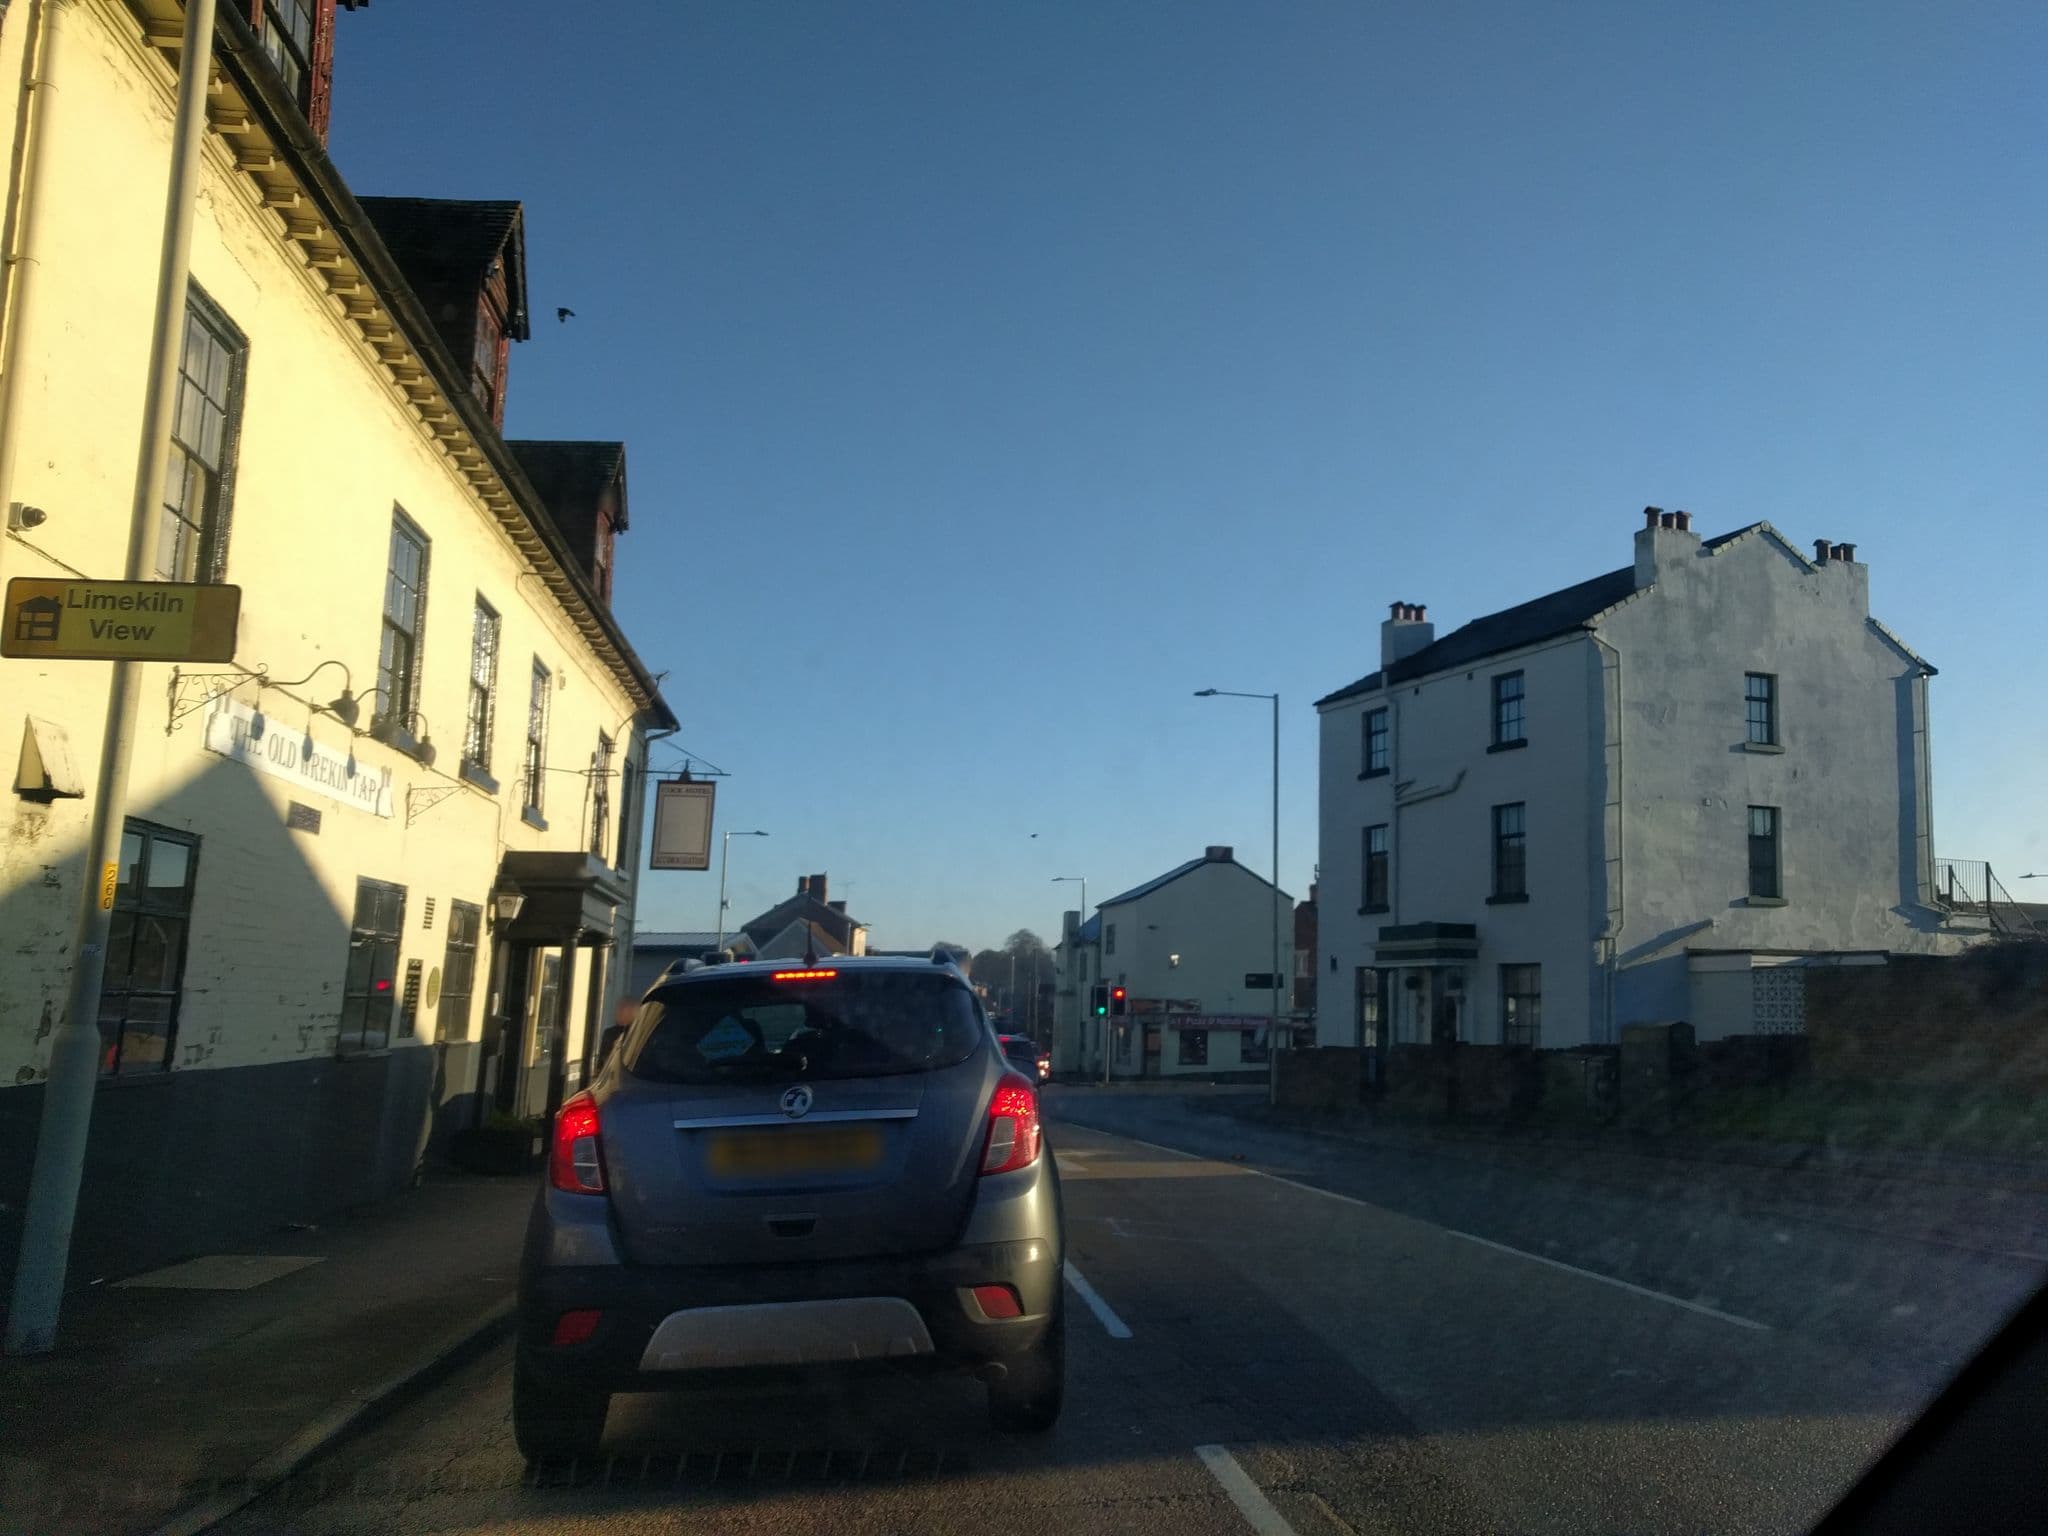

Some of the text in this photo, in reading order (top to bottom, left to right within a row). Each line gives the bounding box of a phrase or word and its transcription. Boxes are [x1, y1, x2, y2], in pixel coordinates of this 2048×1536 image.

[67, 588, 184, 613] Limekiln
[89, 618, 155, 641] View
[269, 733, 297, 768] OLD
[353, 771, 377, 802] TAP
